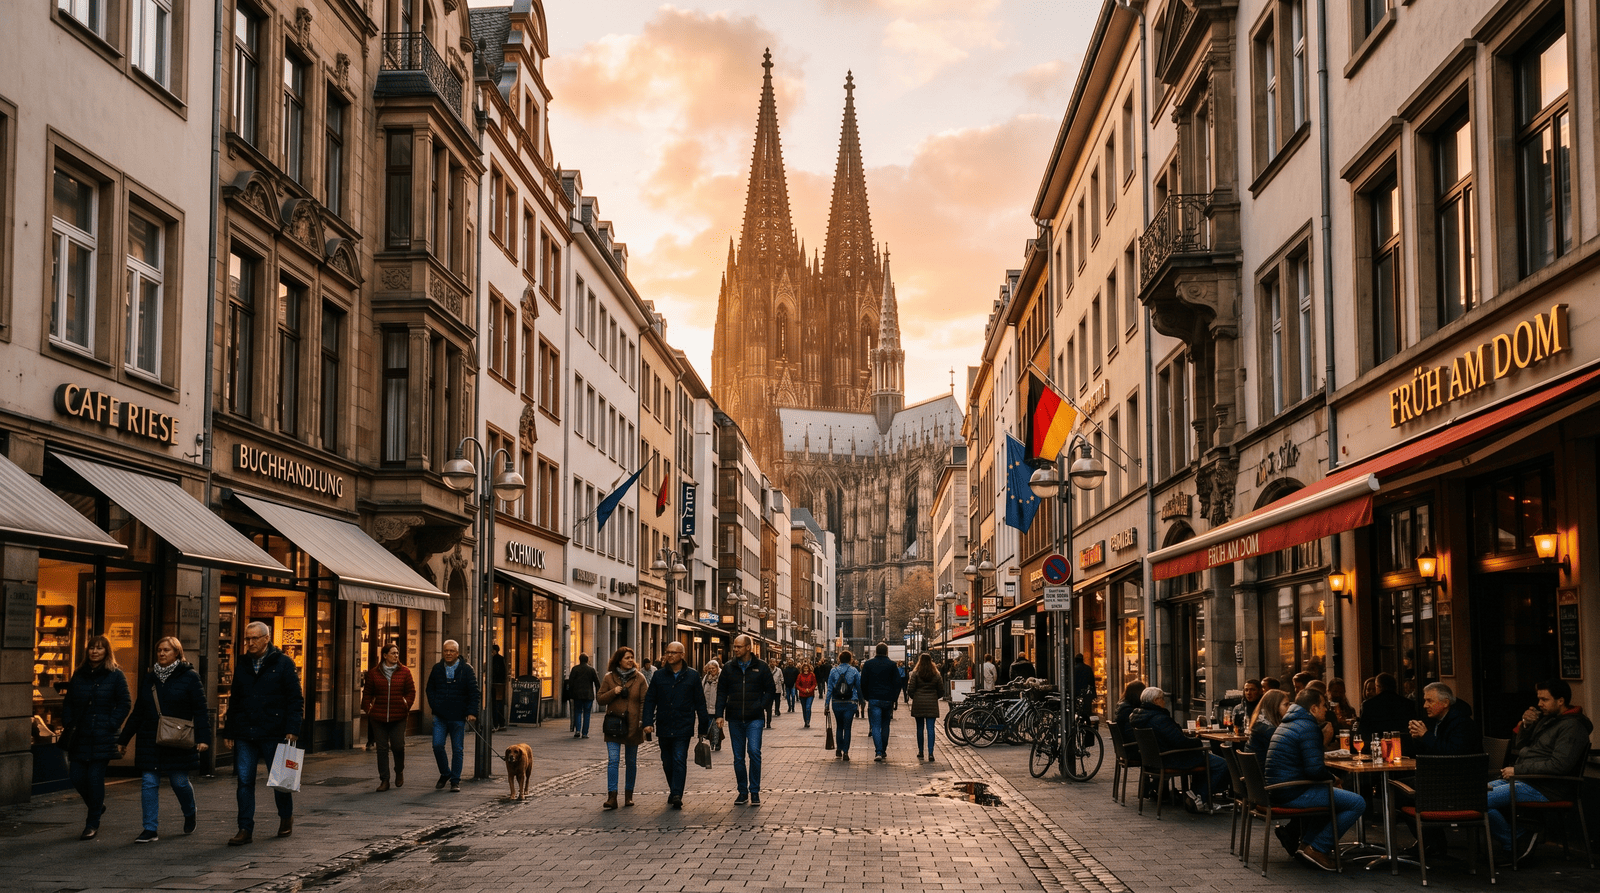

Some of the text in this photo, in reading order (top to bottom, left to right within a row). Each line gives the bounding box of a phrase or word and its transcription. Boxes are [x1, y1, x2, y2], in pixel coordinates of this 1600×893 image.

[1389, 303, 1563, 429] FRÜH AM DOM
[62, 383, 180, 445] CAFE RIESE
[238, 443, 343, 498] BUCHHANDLUNG
[508, 540, 547, 570] SCHMUCK
[1227, 540, 1239, 560] AM
[1240, 533, 1259, 557] DOM
